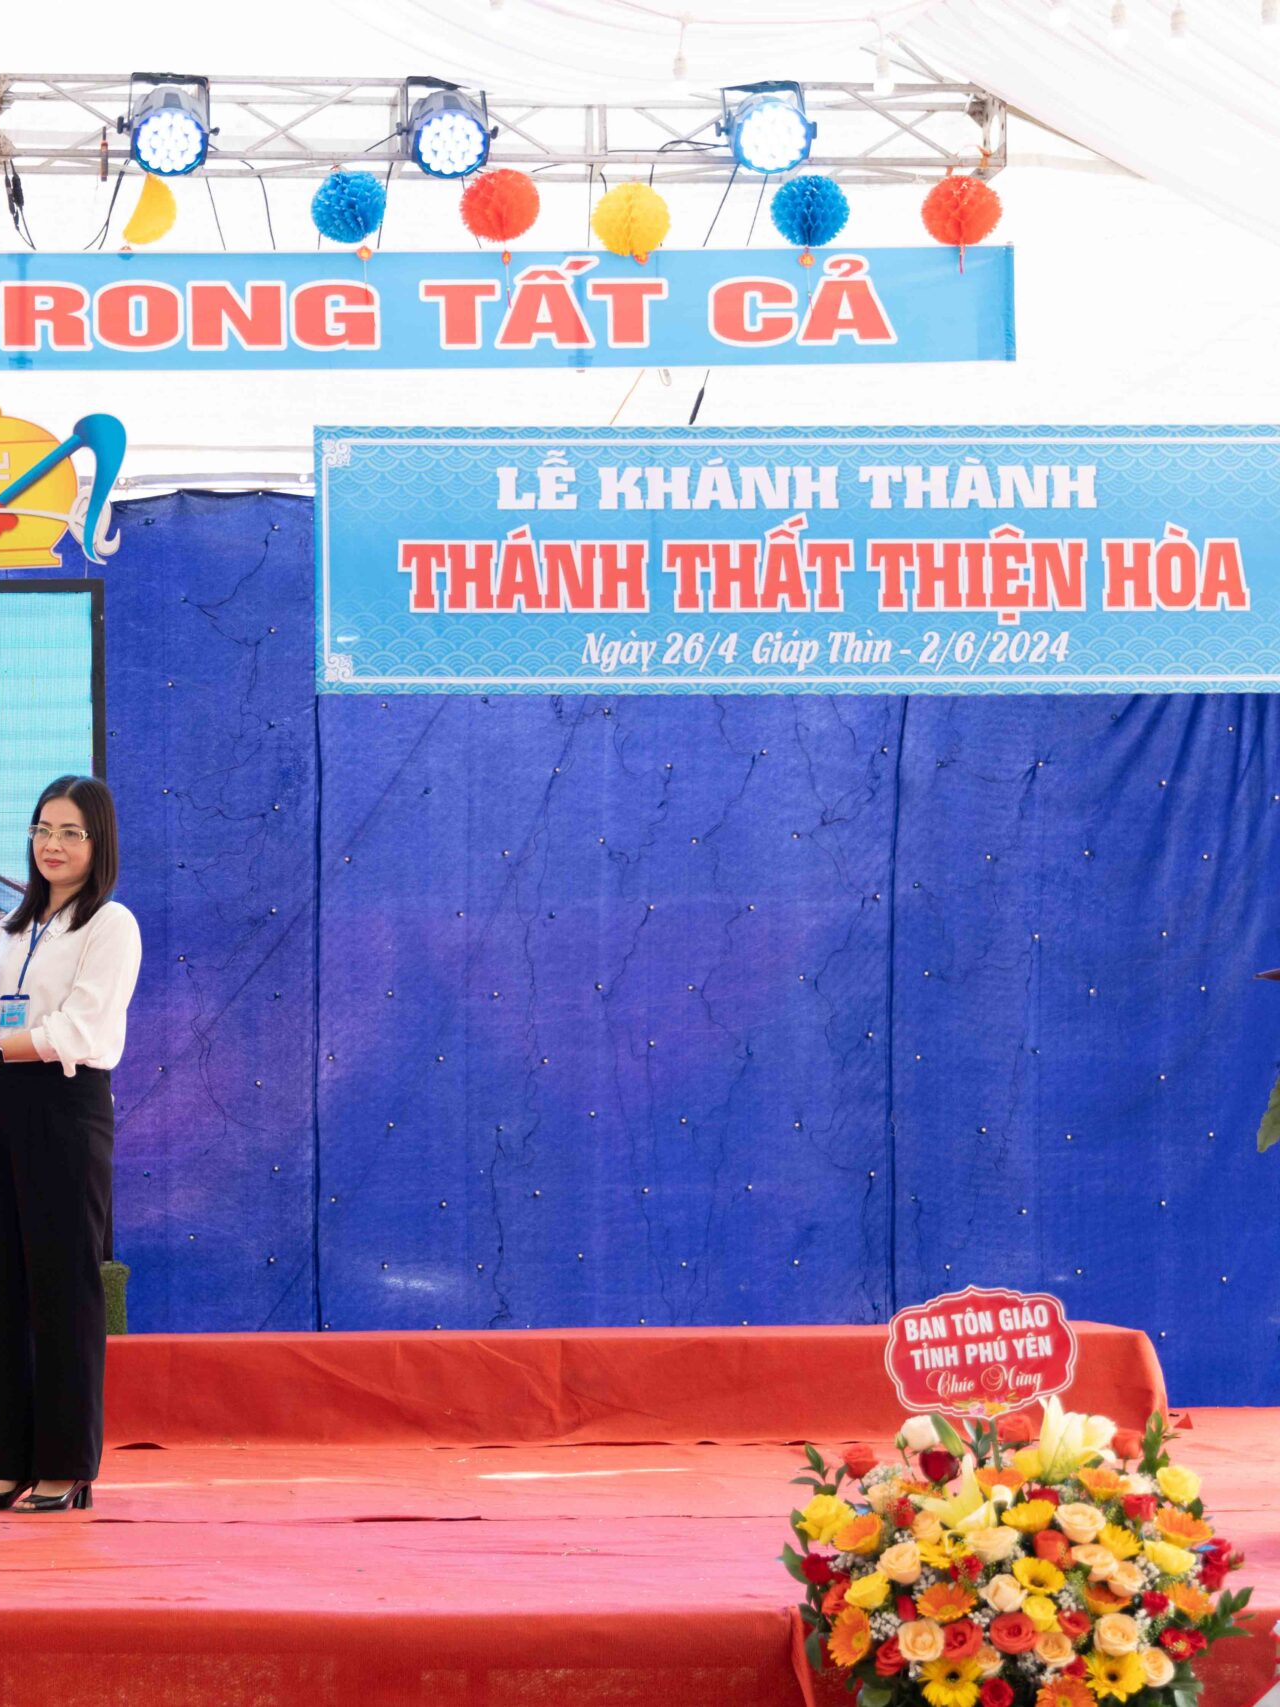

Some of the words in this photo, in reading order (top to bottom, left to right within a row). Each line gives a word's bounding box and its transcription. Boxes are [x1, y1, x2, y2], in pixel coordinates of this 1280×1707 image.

[422, 260, 665, 347] TẤT
[710, 260, 894, 344] CẢ
[497, 451, 577, 511] LỄ
[599, 458, 840, 511] KHÁNH
[860, 457, 1098, 510] THÀNH
[400, 527, 649, 611] THÁNH
[663, 515, 854, 611] THẤT
[867, 525, 1087, 623] THIỆN
[1103, 525, 1250, 611] HÒA
[582, 632, 657, 673] Ngày
[663, 633, 738, 671] 26/4
[752, 631, 819, 673] Giáp
[830, 630, 893, 664] Thìn
[920, 631, 1070, 672] 2/6/2024
[904, 1315, 947, 1342] BAN
[951, 1308, 994, 1337] TÔN
[998, 1301, 1050, 1331] GIÁO
[910, 1342, 959, 1370] TỈNH
[965, 1336, 1007, 1365] PHÚ
[1013, 1333, 1053, 1360] YÊN
[926, 1369, 975, 1398] Chúc
[980, 1363, 1043, 1392] Mừng
